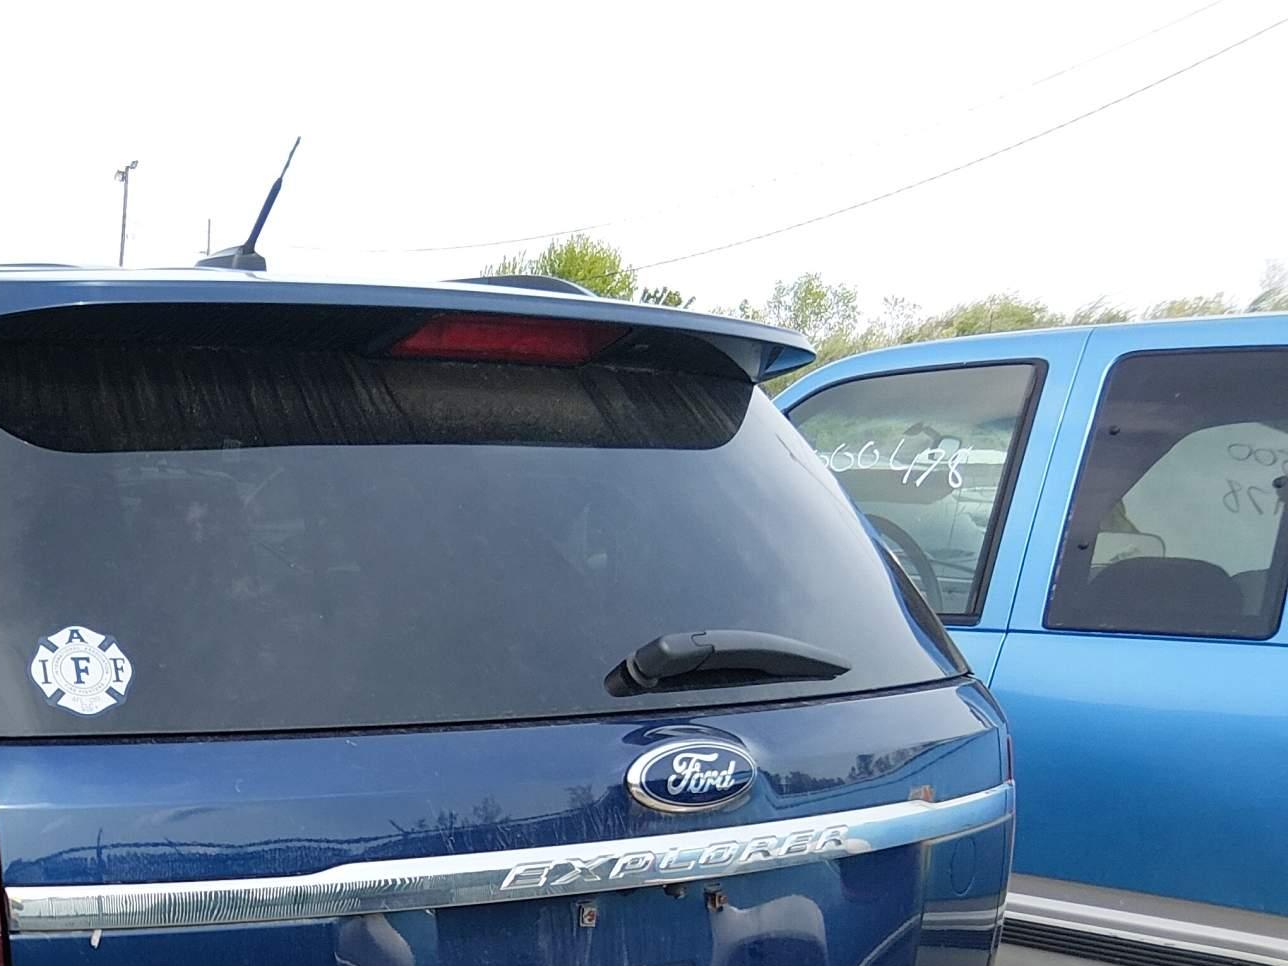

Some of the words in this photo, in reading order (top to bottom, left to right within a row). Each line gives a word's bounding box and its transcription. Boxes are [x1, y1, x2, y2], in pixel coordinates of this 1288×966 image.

[65, 629, 88, 644] A
[39, 659, 52, 684] I
[70, 656, 90, 684] F
[109, 657, 125, 682] F
[667, 752, 736, 795] Ford
[500, 824, 849, 891] EXPLORER
